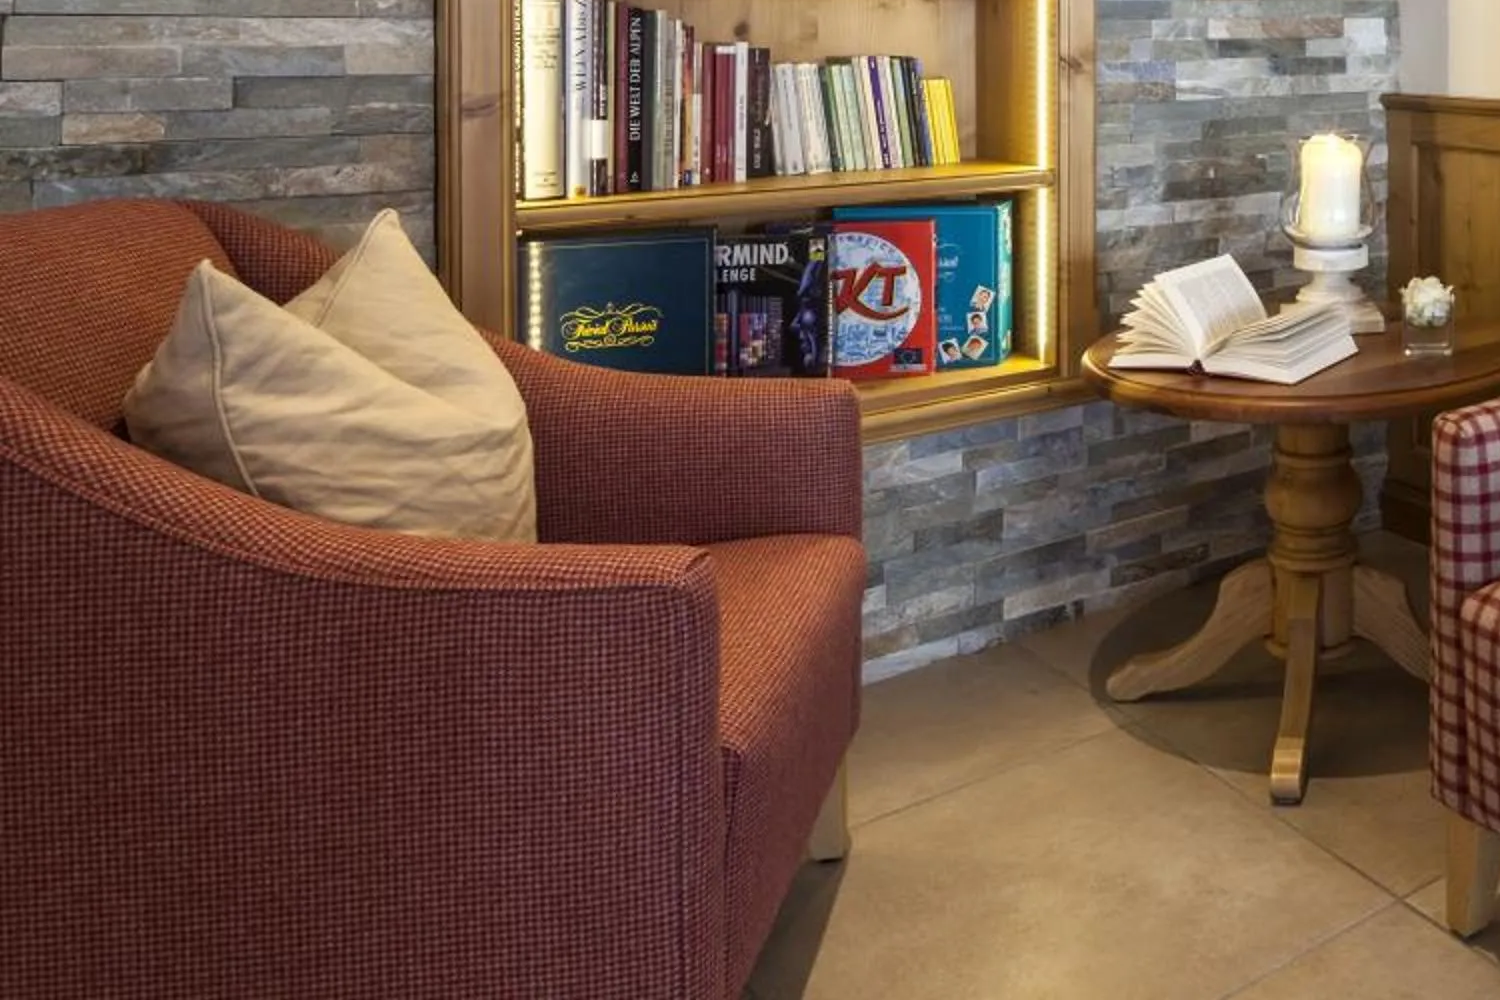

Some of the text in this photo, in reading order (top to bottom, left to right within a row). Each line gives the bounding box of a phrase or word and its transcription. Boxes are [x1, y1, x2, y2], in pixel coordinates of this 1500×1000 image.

[629, 58, 642, 83] DER
[629, 85, 642, 117] WELT
[629, 120, 642, 141] DIE
[716, 242, 789, 267] RMIND
[832, 262, 909, 320] KT
